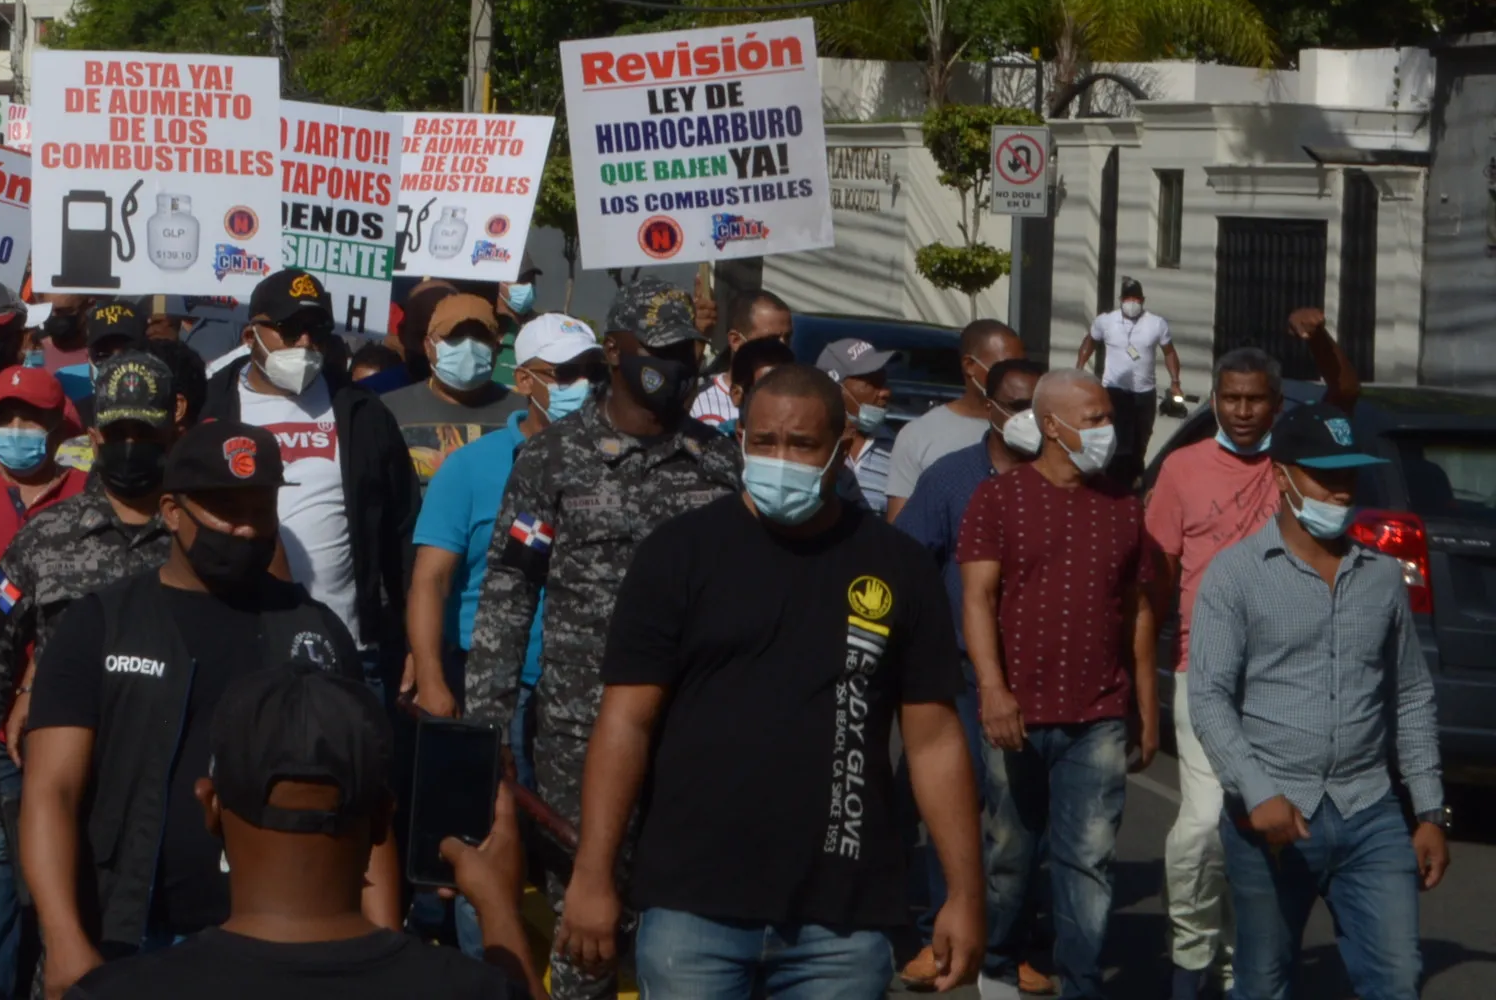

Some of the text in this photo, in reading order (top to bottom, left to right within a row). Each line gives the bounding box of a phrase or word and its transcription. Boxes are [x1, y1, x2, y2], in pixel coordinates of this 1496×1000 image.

[581, 31, 803, 86] Revisión
[84, 61, 233, 92] BASTA YA!
[64, 87, 252, 120] DE AUMENTO
[647, 81, 745, 116] LEY DE
[109, 116, 208, 146] DE LOS
[293, 119, 391, 165] JARTO!!
[413, 117, 517, 137] BASTA YA!
[595, 104, 803, 155] HIDROCARBURO
[40, 142, 274, 177] COMBUSTIBLES
[424, 137, 525, 157] AUMENTO
[421, 155, 489, 174] DE LOS
[600, 142, 790, 186] QUE BAJEN YA!
[280, 159, 392, 206] TAPONES
[600, 194, 640, 216] LOS
[644, 177, 813, 213] COMBUSTIBLES
[995, 191, 1042, 200] NO DOBLE
[1022, 199, 1031, 208] U
[162, 228, 185, 238] GLP
[717, 220, 764, 239] CNTT
[219, 255, 265, 271] CNTT
[95, 304, 134, 321] RUTA
[345, 294, 368, 334] H
[104, 654, 166, 679] ORDEN
[833, 760, 844, 777] CA
[840, 653, 878, 860] BODY GLOVE
[830, 782, 842, 818] SINCE
